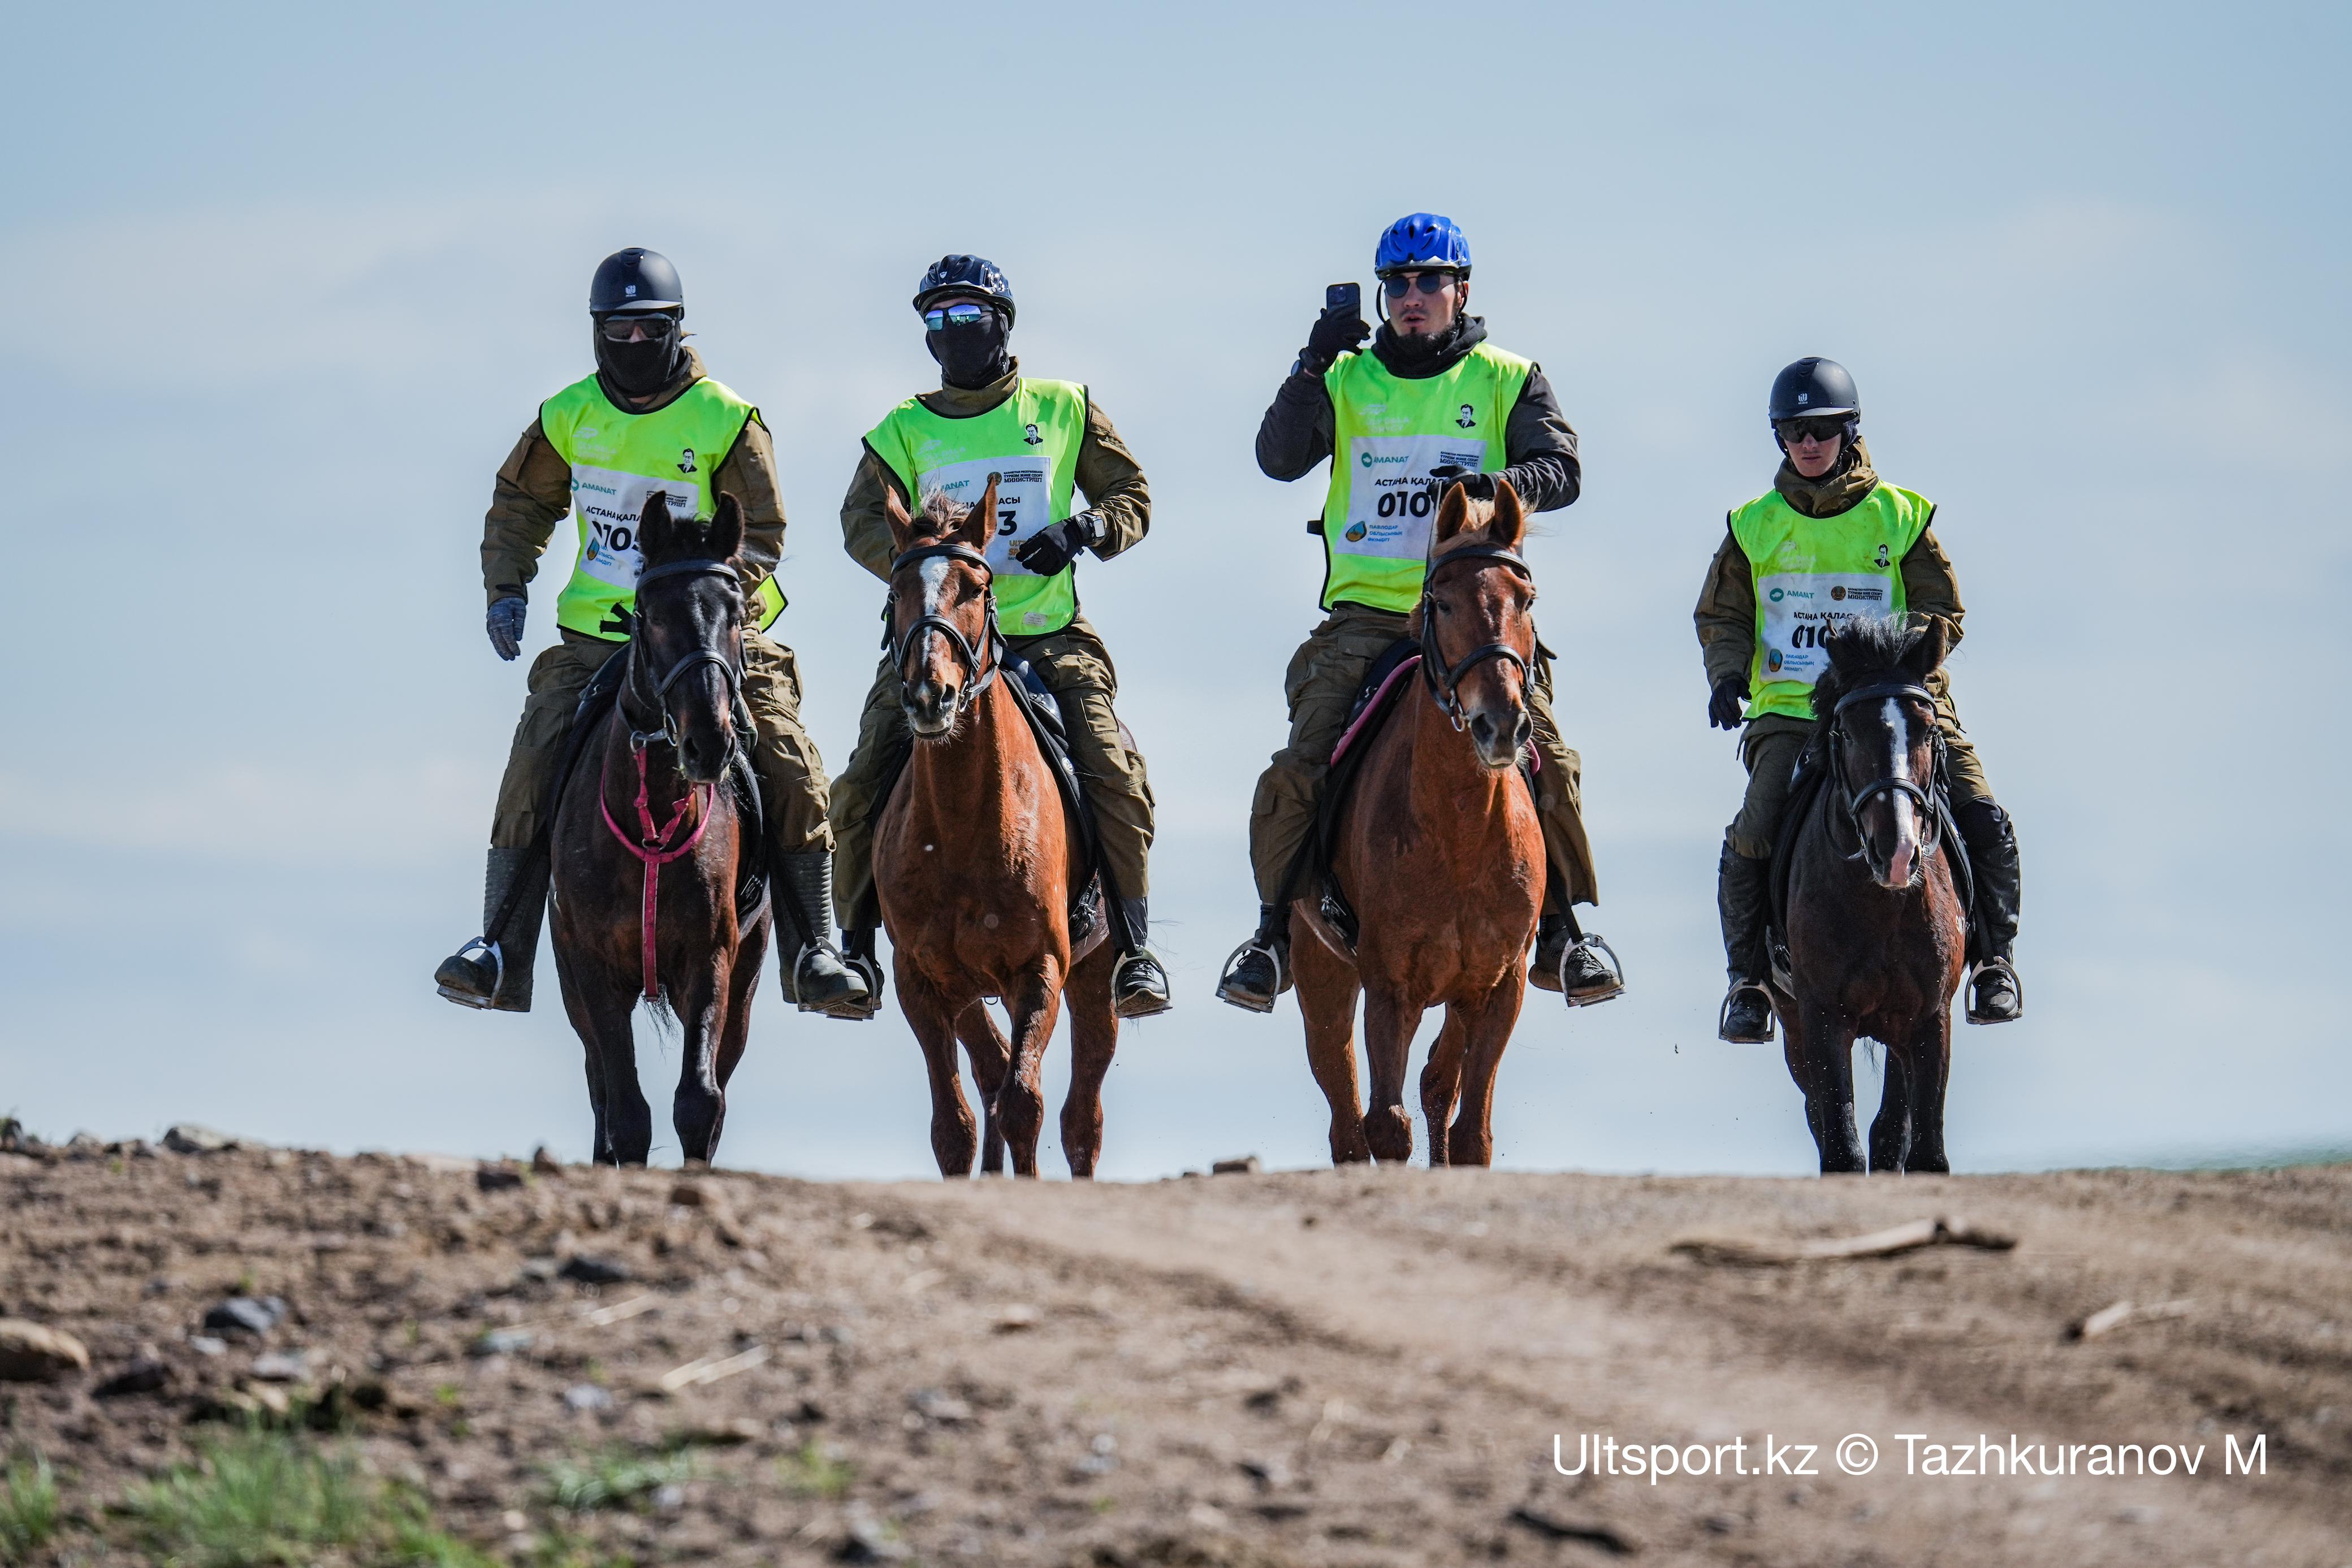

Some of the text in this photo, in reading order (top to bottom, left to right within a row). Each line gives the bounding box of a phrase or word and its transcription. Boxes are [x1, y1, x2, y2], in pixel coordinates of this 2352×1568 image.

[582, 482, 617, 495] AMANAT
[1377, 491, 1431, 518] 010
[586, 505, 616, 519] АСТАНА
[1793, 612, 1818, 621] АСТАНА
